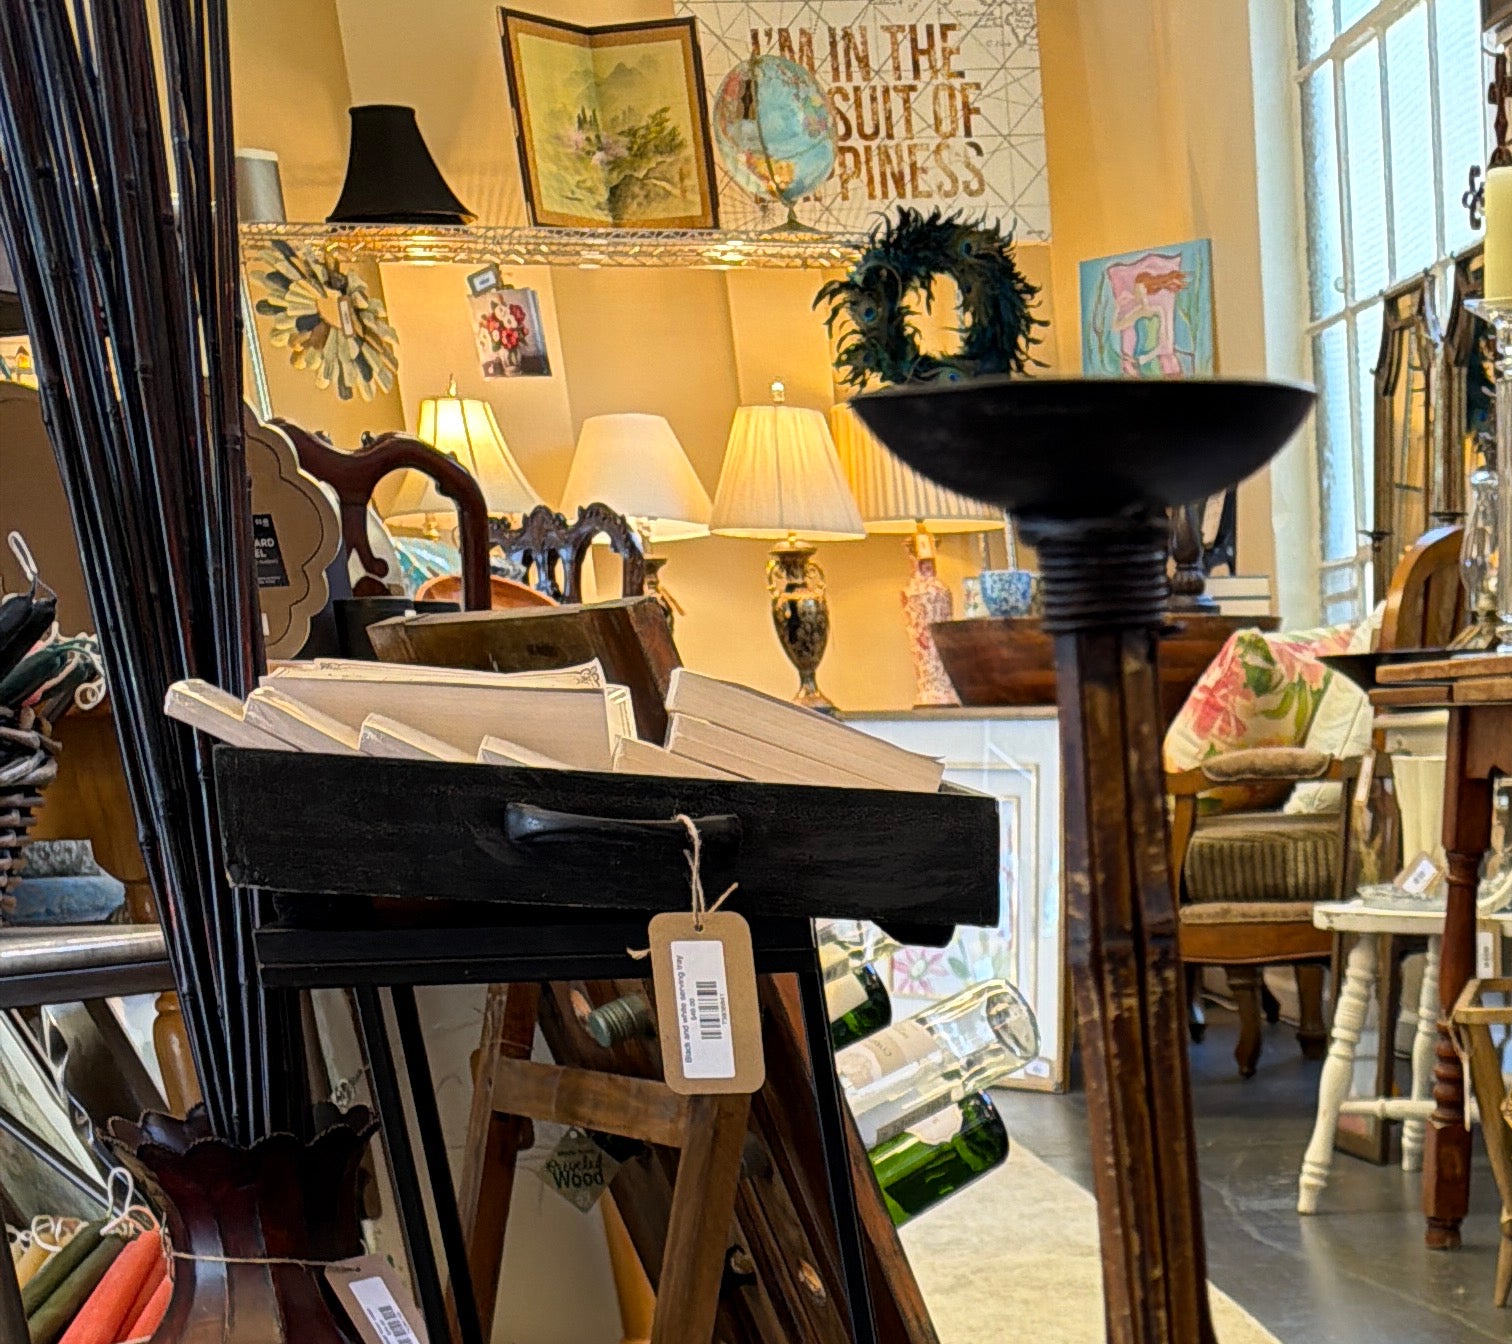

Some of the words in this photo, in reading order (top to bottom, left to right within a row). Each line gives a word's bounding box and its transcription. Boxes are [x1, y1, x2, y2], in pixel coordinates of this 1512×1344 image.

[828, 25, 871, 82] IN
[880, 23, 965, 80] THE
[826, 84, 918, 141] SUIT
[932, 82, 982, 139] OF
[826, 141, 985, 201] PINESS
[550, 1169, 604, 1188] Wood
